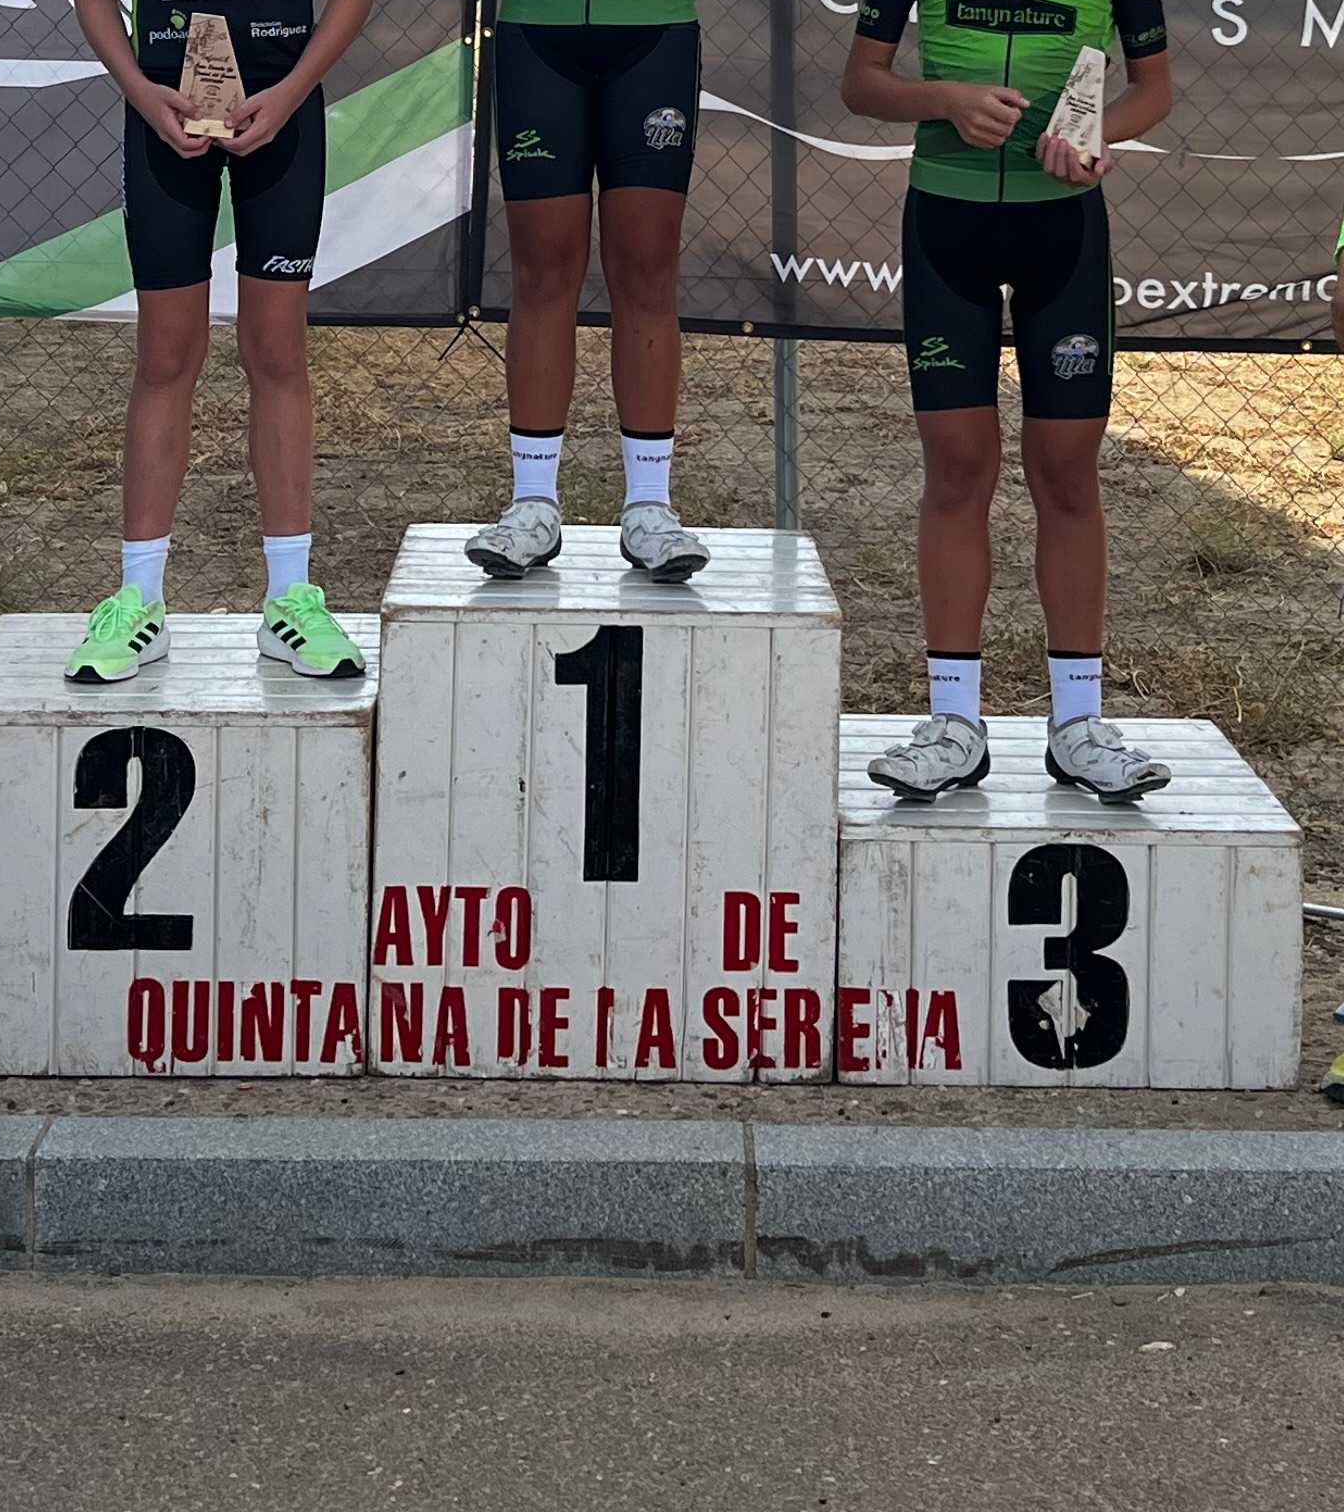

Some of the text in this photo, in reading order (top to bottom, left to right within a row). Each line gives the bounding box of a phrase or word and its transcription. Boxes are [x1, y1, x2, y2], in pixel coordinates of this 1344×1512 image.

[149, 27, 190, 45] podoa
[957, 2, 1067, 28] tanynature
[554, 625, 644, 883] 1
[68, 726, 197, 952] 2
[373, 885, 800, 973] AYTO DE
[1007, 844, 1131, 1070] 3
[127, 977, 471, 1073] QUINTANA
[498, 987, 570, 1069] DE
